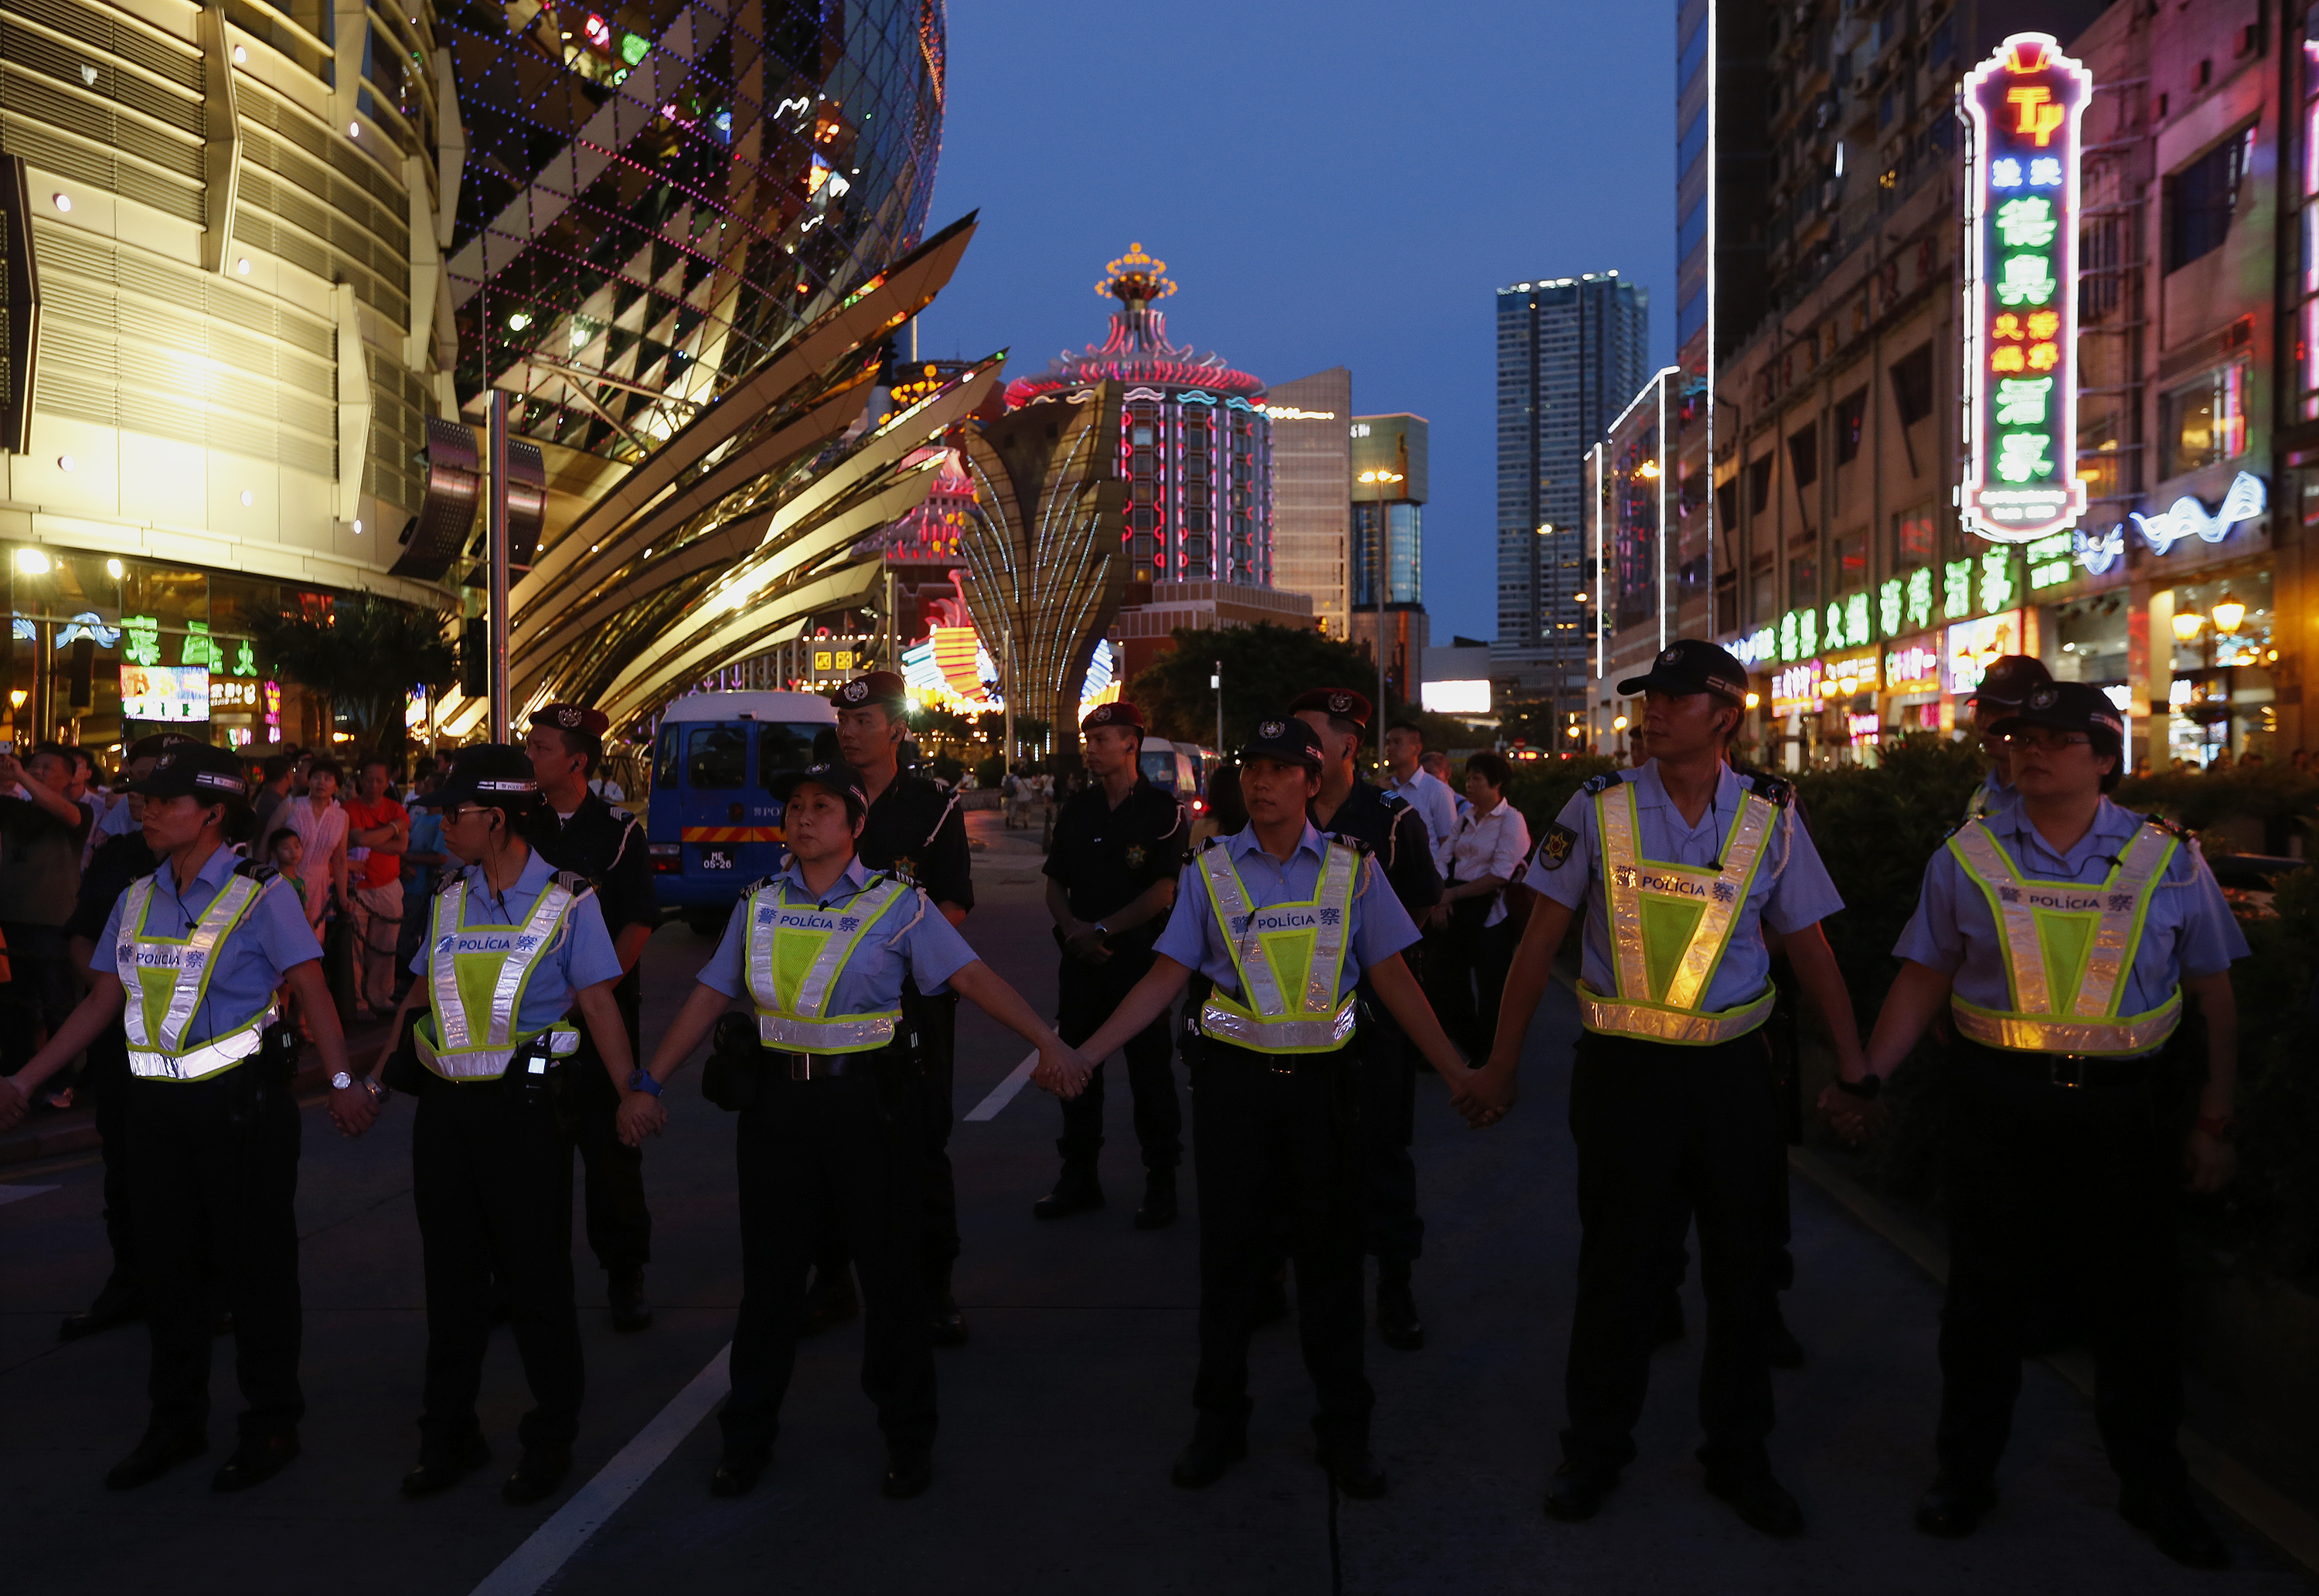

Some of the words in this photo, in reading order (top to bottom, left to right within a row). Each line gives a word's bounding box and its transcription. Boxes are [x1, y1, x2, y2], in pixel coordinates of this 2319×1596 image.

[703, 859, 732, 869] 05-26
[711, 851, 724, 860] ME
[1712, 882, 1734, 903] 察
[2030, 895, 2100, 909] POLÍCIA
[2108, 893, 2133, 911] 察
[758, 907, 778, 924] 警
[780, 915, 833, 929] POLÍCIA
[838, 917, 860, 932] 察
[1258, 914, 1315, 929] POLÍCIA
[1320, 907, 1340, 926] 察
[458, 937, 510, 950] POLÍCIA
[516, 935, 537, 951] 察
[186, 950, 204, 968] 察
